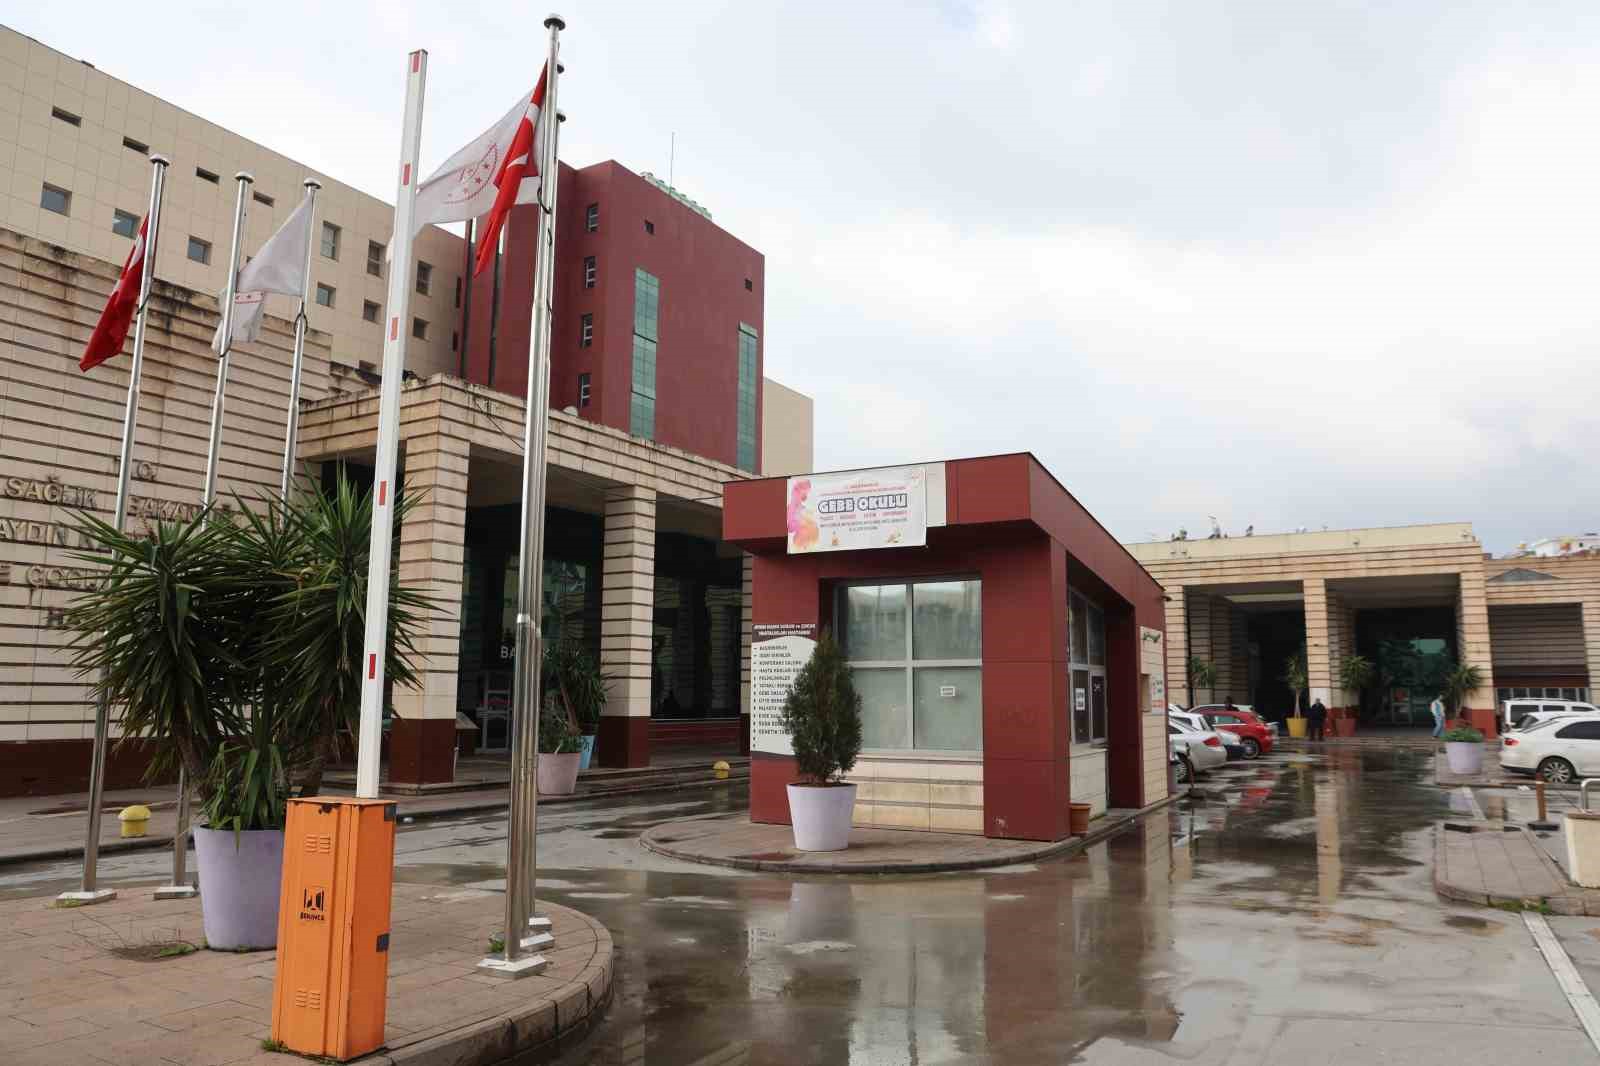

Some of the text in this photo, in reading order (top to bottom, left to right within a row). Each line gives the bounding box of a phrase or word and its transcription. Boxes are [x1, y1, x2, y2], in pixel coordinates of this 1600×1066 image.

[5, 473, 98, 508] SAĞLIK
[818, 493, 908, 513] GEBE OKULU
